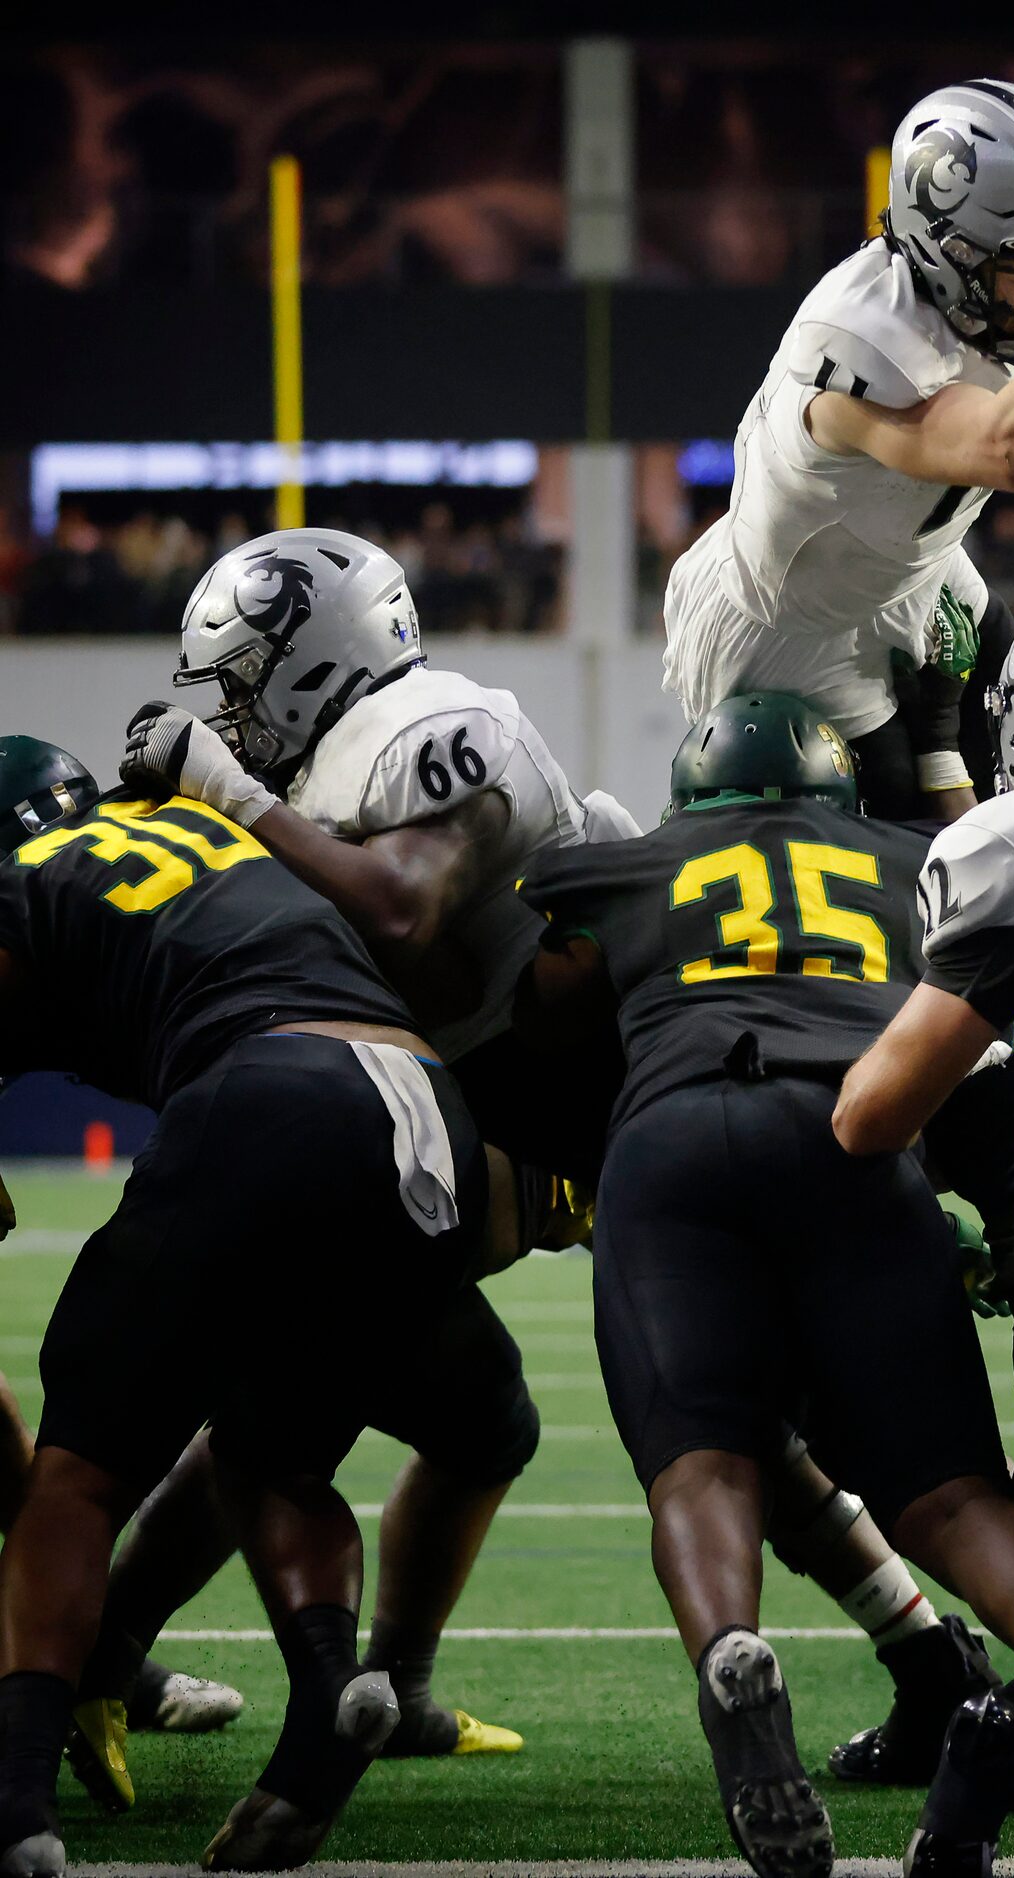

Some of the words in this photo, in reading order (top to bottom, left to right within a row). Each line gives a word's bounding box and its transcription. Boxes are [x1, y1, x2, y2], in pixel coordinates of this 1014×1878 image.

[417, 726, 487, 801] 66
[15, 795, 273, 914] 30
[917, 856, 960, 938] 12
[669, 839, 890, 985] 35
